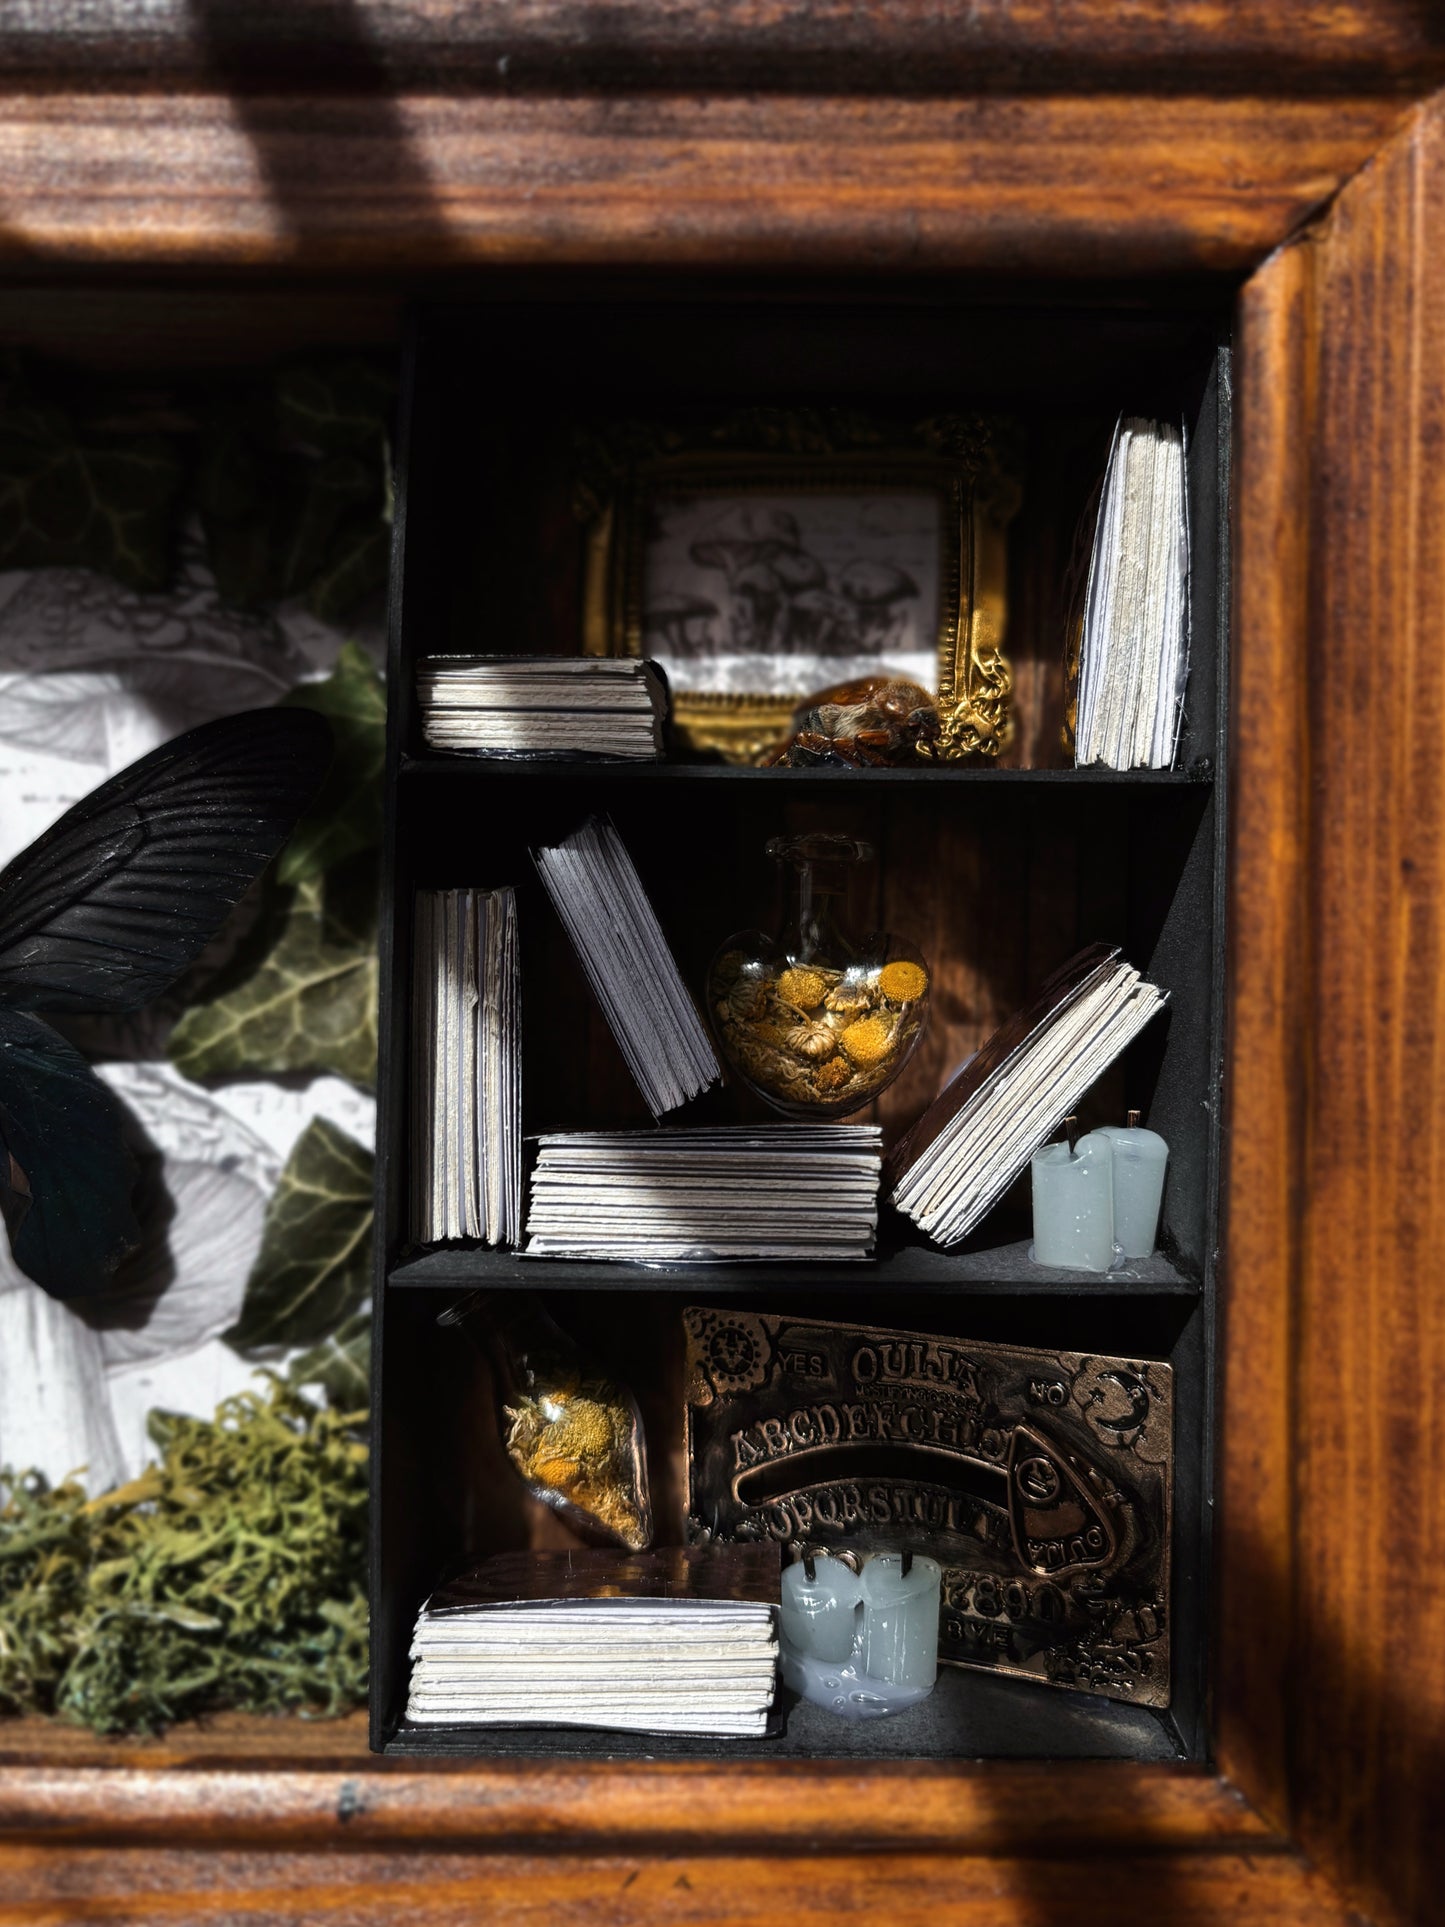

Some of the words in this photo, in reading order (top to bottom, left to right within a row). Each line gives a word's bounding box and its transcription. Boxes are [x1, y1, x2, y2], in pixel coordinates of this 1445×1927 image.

[776, 1350, 823, 1377] YES
[853, 1343, 981, 1401] OUIJA
[1029, 1380, 1066, 1406] NO
